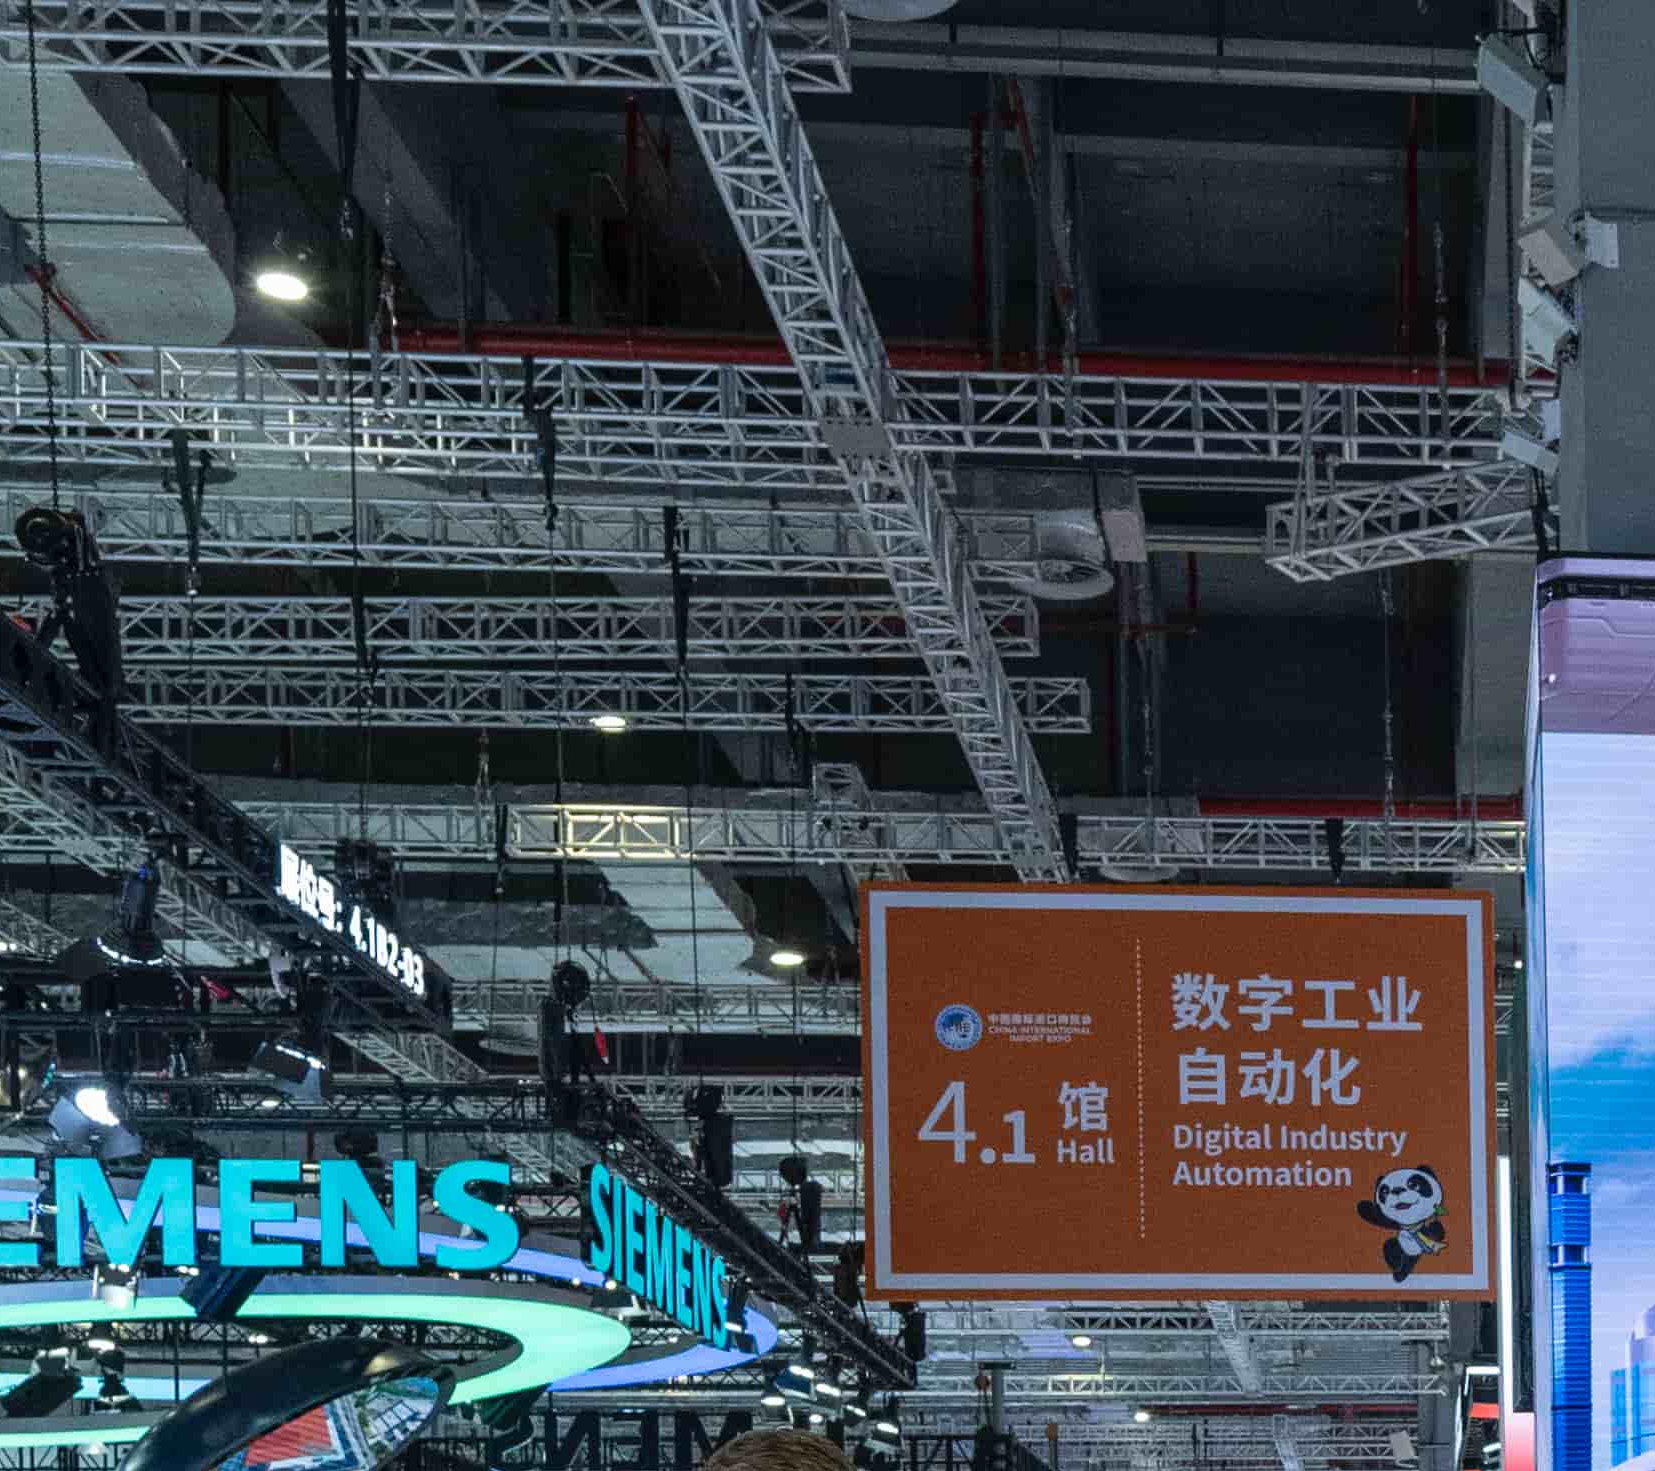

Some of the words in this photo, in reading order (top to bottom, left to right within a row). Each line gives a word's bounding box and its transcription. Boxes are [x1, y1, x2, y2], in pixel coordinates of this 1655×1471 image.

[1170, 972, 1423, 1033] 数字工业
[1178, 1047, 1362, 1107] 自动化
[917, 1080, 1036, 1165] 4.1
[1057, 1080, 1110, 1133] 馆
[1056, 1138, 1115, 1166] Hall
[1172, 1123, 1273, 1158] Digital
[1279, 1123, 1407, 1158] Industry
[1172, 1159, 1353, 1188] Automation
[586, 1160, 735, 1353] SIEMENS
